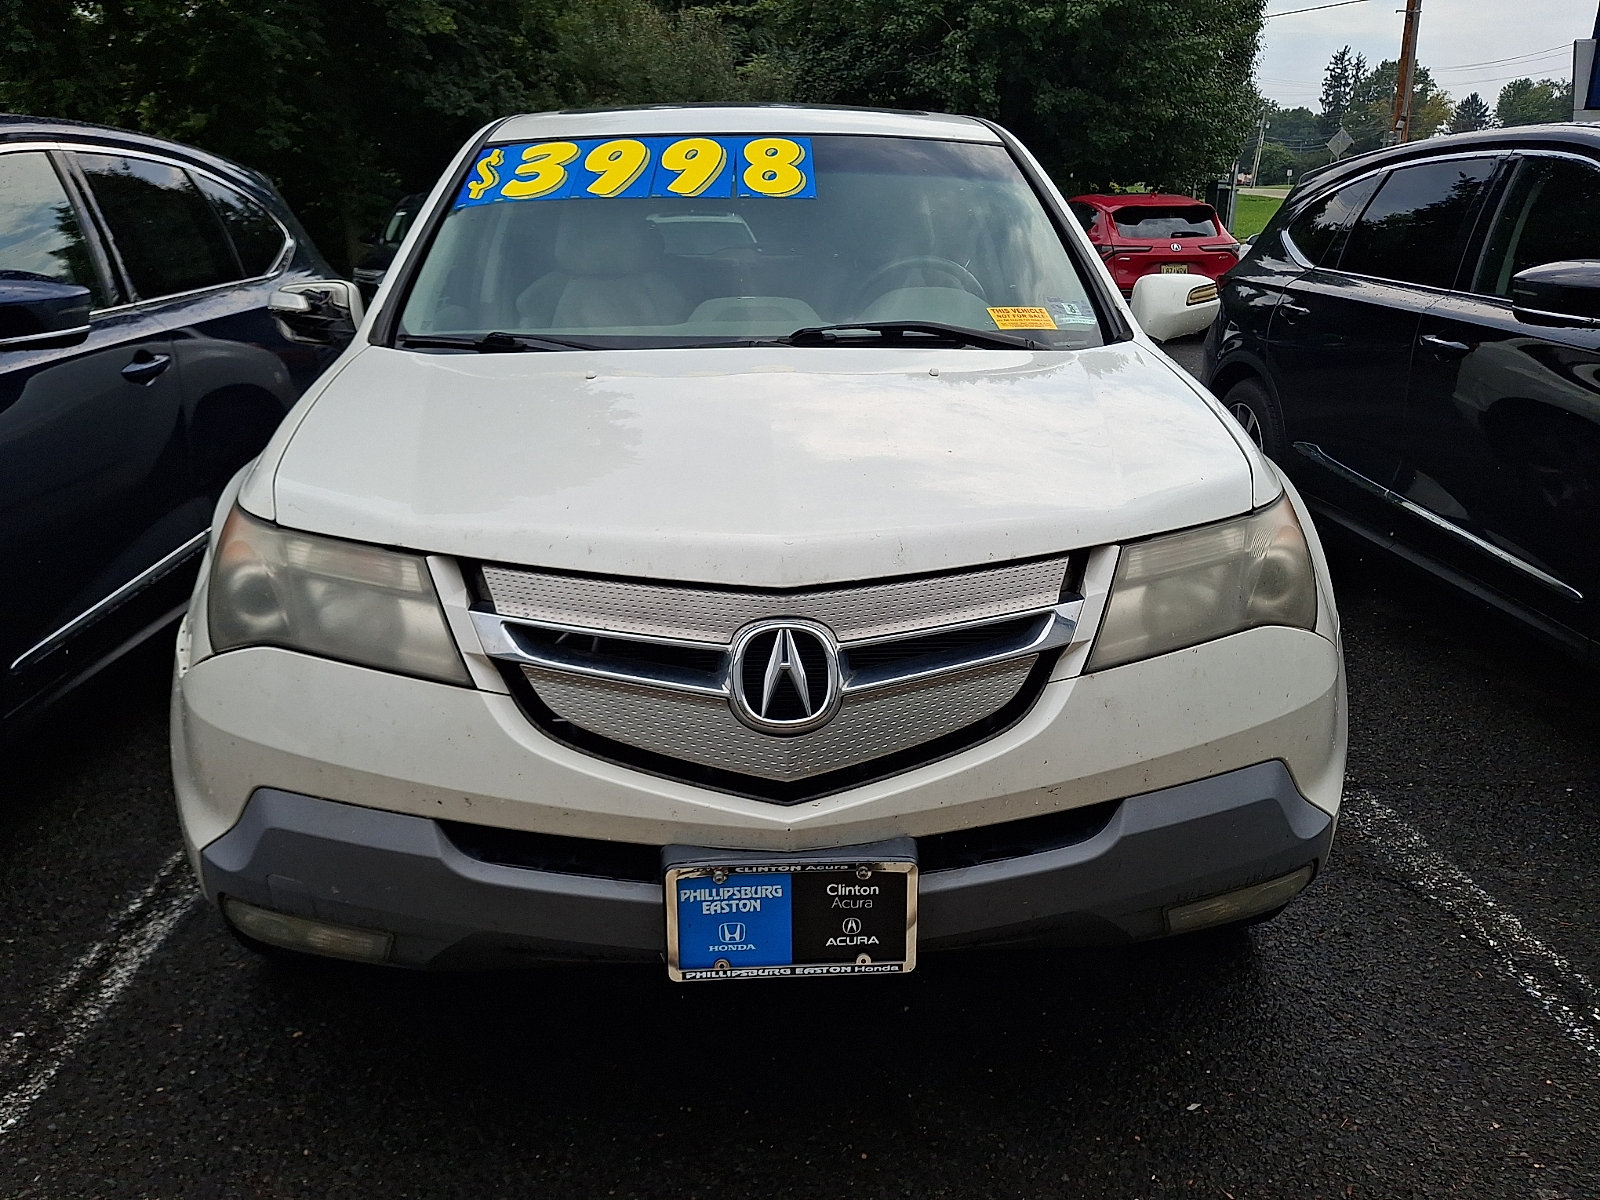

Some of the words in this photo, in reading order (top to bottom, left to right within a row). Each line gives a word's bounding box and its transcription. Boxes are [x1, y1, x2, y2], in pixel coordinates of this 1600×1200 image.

[468, 138, 806, 199] $3998
[735, 865, 802, 873] CLINTON
[680, 885, 783, 903] PHILLIPSBURG
[826, 884, 880, 896] Clinton
[702, 899, 761, 915] EASTON
[831, 897, 873, 909] Acura
[826, 935, 880, 947] ACURA
[709, 943, 756, 952] HONDA
[686, 968, 791, 979] PHILLIPSBURG
[795, 965, 852, 975] EASTON
[854, 964, 899, 973] Honda
